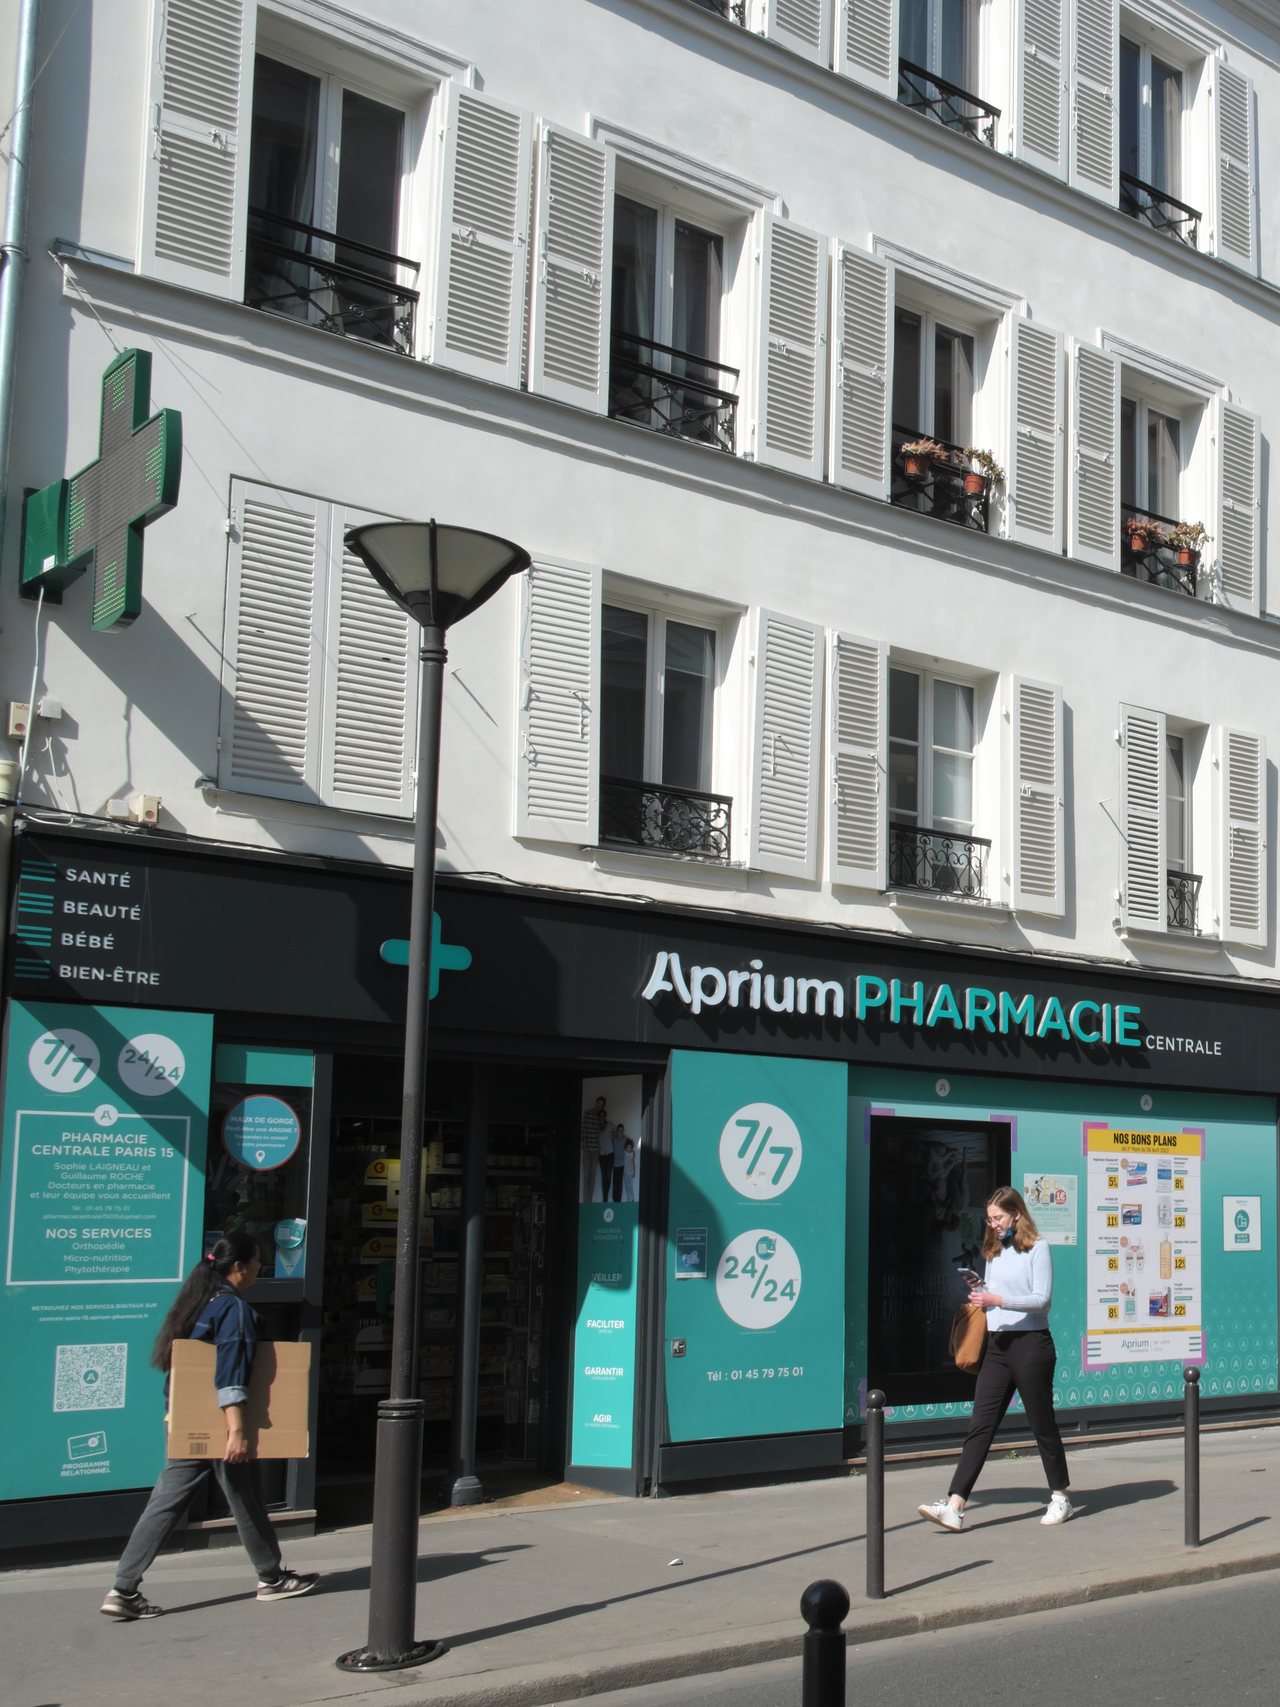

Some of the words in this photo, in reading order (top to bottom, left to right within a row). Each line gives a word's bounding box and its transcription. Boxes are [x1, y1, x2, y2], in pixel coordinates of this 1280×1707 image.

[66, 867, 131, 888] SANTÉ
[63, 901, 141, 921] BEAUTÉ
[61, 931, 114, 950] BÉBÉ
[59, 965, 160, 985] BIEN-ÊTRE
[642, 951, 844, 1019] Aprium
[856, 974, 1142, 1047] PHARMACIE
[1146, 1034, 1222, 1056] CENTRALE
[43, 1038, 92, 1083] 7/7
[124, 1049, 181, 1080] 24/24
[255, 1116, 266, 1124] DE
[62, 1132, 148, 1144] PHARMACIE
[1113, 1132, 1129, 1145] NOS
[1132, 1134, 1152, 1146] BONS
[1154, 1135, 1177, 1147] PLANS
[32, 1145, 110, 1156] CENTRALE
[115, 1147, 157, 1157] PARIS
[161, 1148, 174, 1158] 15
[735, 1118, 794, 1186] 7/7
[54, 1162, 86, 1172] Sophie
[61, 1172, 107, 1180] Guillaume
[48, 1182, 90, 1190] Docteurs
[108, 1182, 155, 1192] pharmacie
[64, 1191, 95, 1201] équipe
[46, 1228, 77, 1239] NOS
[82, 1228, 152, 1239] SERVICES
[72, 1242, 126, 1251] Orthopédie
[64, 1254, 132, 1262] Micro-nutrition
[64, 1266, 130, 1274] Phytothérapie
[724, 1255, 796, 1302] 24/24
[586, 1320, 624, 1328] FACILITER
[1122, 1340, 1149, 1349] Aprium
[584, 1366, 624, 1376] GARANTIR
[706, 1370, 722, 1382] Tél
[731, 1370, 742, 1380] 01
[746, 1369, 758, 1379] 45
[762, 1368, 774, 1378] 79
[778, 1368, 789, 1377] 75
[792, 1366, 804, 1376] 01
[593, 1414, 612, 1423] AGIR
[62, 1460, 110, 1470] PROGRAMME
[60, 1468, 111, 1476] RELATIONNEL
